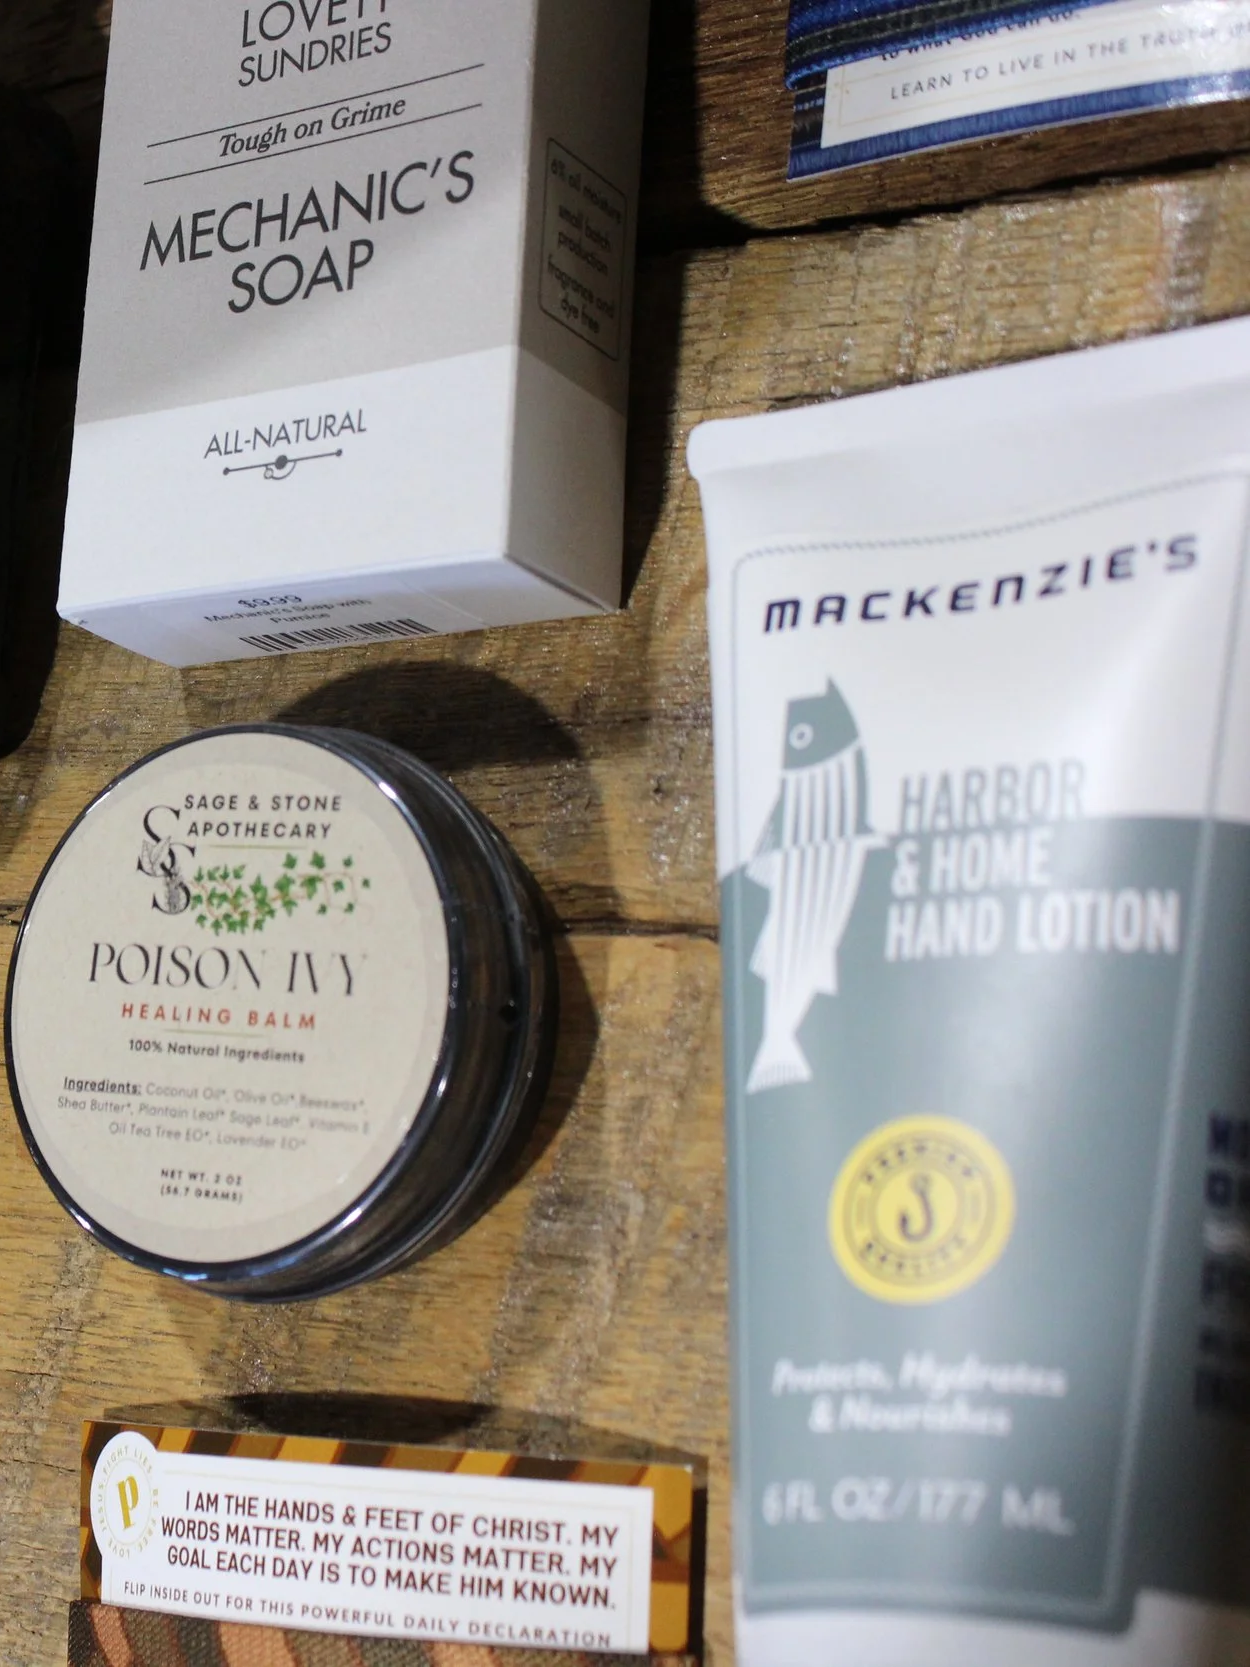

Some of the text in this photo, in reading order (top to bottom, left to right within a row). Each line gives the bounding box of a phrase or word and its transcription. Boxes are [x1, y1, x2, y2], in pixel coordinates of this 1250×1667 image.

[238, 22, 392, 87] SUNDRIES
[890, 73, 952, 100] LEARN
[962, 65, 989, 83] TO
[999, 54, 1044, 76] LIVE
[1053, 48, 1076, 65] IN
[1087, 37, 1128, 59] THE
[219, 99, 406, 157] Tough on Grime
[139, 150, 475, 271] MECHANIC'S
[227, 238, 375, 314] SOAP
[203, 408, 368, 459] ALL-NATURAL
[762, 533, 1198, 635] MACKENZIE'S
[184, 794, 343, 812] SAGE & STONE
[900, 757, 1086, 835] HARBOR
[187, 822, 332, 840] APOTHECARY
[890, 825, 1055, 898] & HOME
[884, 886, 1181, 963] HAND LOTION
[89, 942, 368, 997] POISON IVY
[121, 1002, 317, 1031] HEALING BALM
[128, 1038, 305, 1063] 100% Natural Ingredients
[57, 1096, 87, 1112] Shea
[138, 1103, 189, 1119] Plantain
[63, 1076, 142, 1096] Ingredients:
[146, 1082, 199, 1099] Coconut
[108, 1121, 127, 1135] Oil
[130, 1123, 152, 1138] Tea
[155, 1126, 181, 1140] Tree
[160, 1168, 183, 1181] NET
[161, 1516, 618, 1580] WORDS MATTER. MY ACTIONS MATTER. MY
[185, 1490, 619, 1549] I AM THE HANDS & FEET OF CHRIST. MY
[167, 1545, 617, 1611] GOAL EACH DAY IS TO MAKE HIM KNOWN.
[124, 1581, 611, 1649] FLIP INSIDE OUT FOR THIS POWERFUL DAILY DECLARATION
